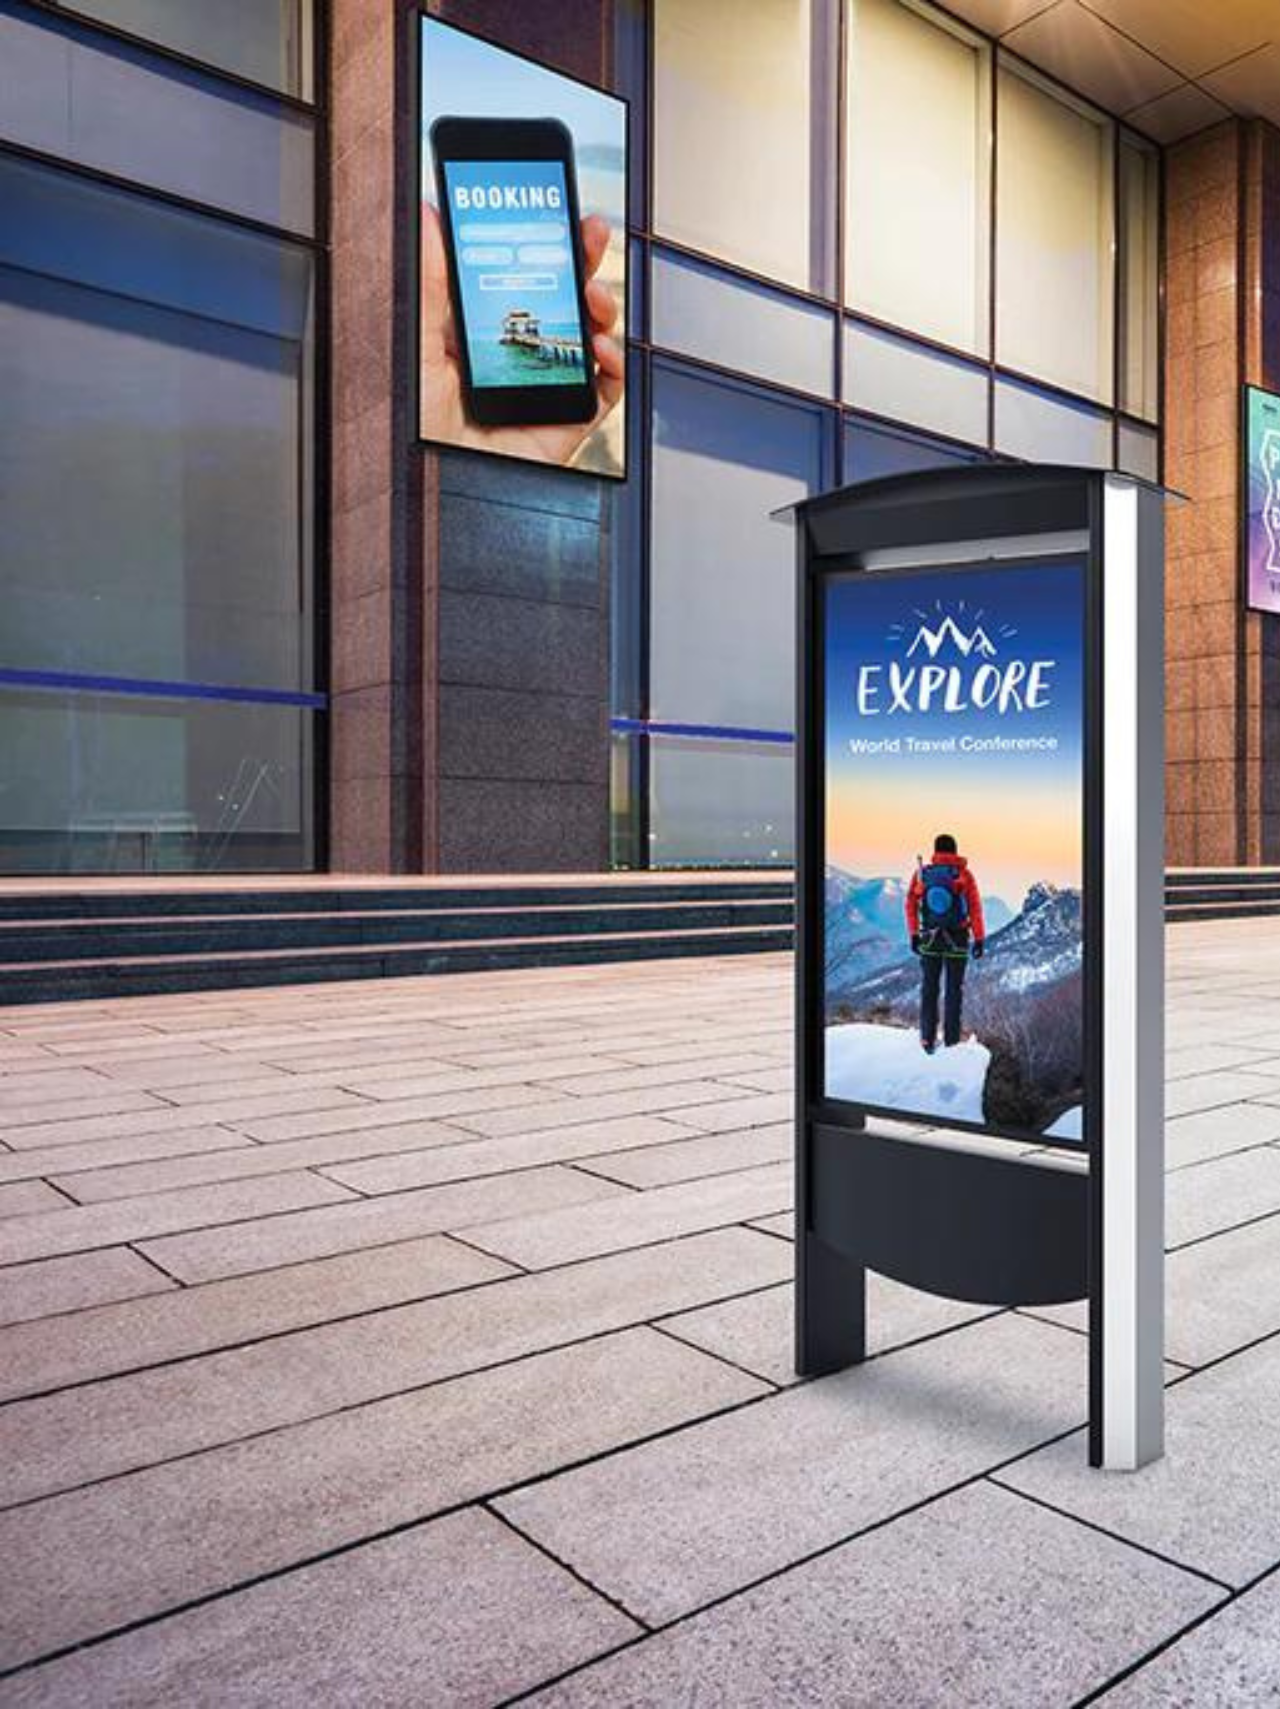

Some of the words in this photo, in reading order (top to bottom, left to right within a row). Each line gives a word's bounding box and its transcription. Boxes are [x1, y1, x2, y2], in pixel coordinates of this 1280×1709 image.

[454, 186, 561, 209] BOOKING
[857, 659, 1056, 716] EXPLORE
[849, 738, 899, 754] World
[906, 737, 955, 752] Travel
[960, 736, 1058, 751] Conference
